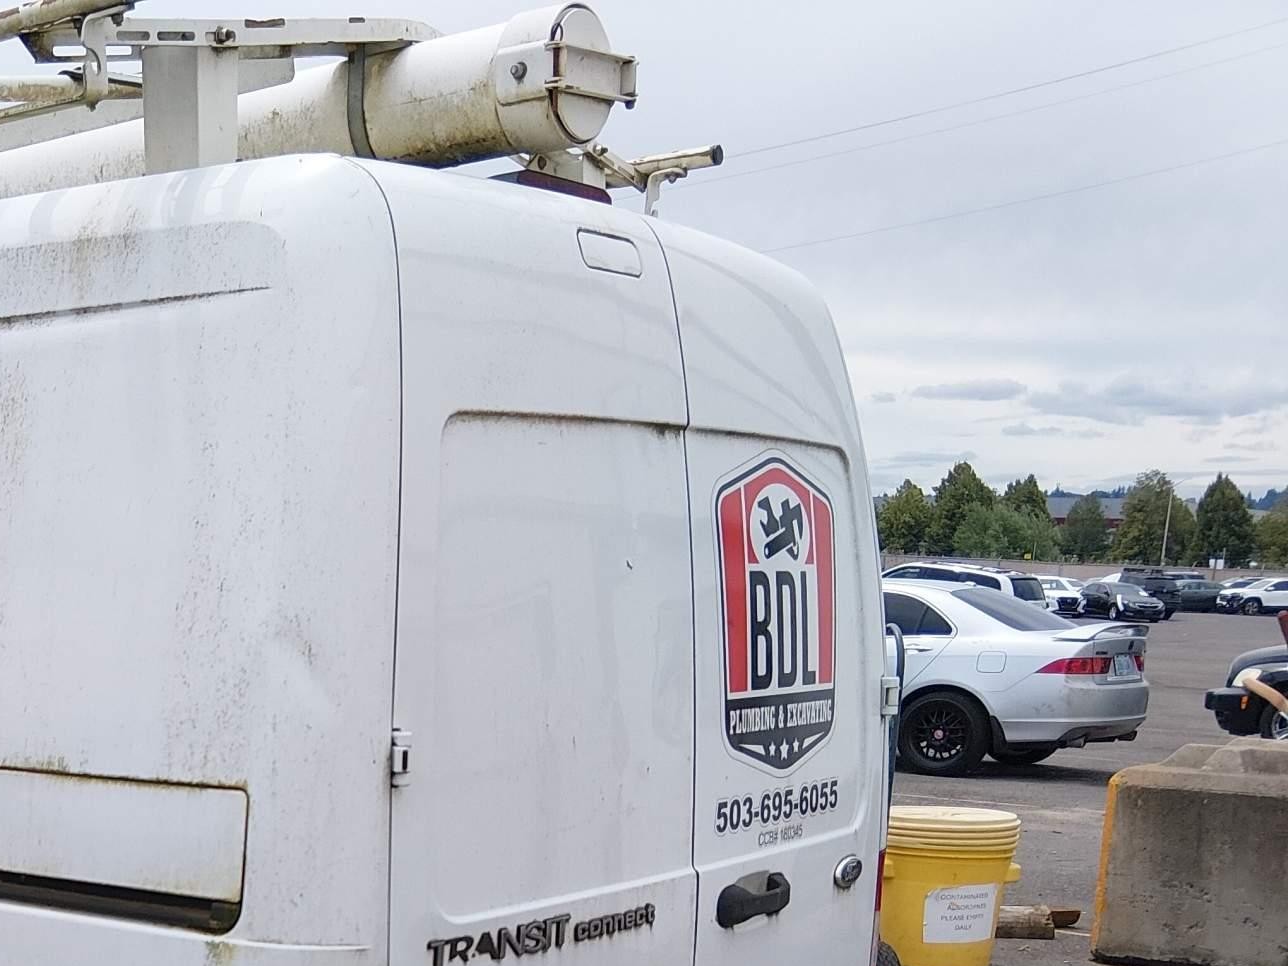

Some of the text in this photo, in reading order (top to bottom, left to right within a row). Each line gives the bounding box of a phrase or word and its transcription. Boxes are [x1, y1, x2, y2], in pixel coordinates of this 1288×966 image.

[749, 570, 817, 691] BDL
[729, 699, 832, 735] PLUMBING & EXCAVATING
[716, 780, 838, 833] 503-695-6055
[758, 831, 779, 847] CCB#
[574, 903, 655, 942] connect
